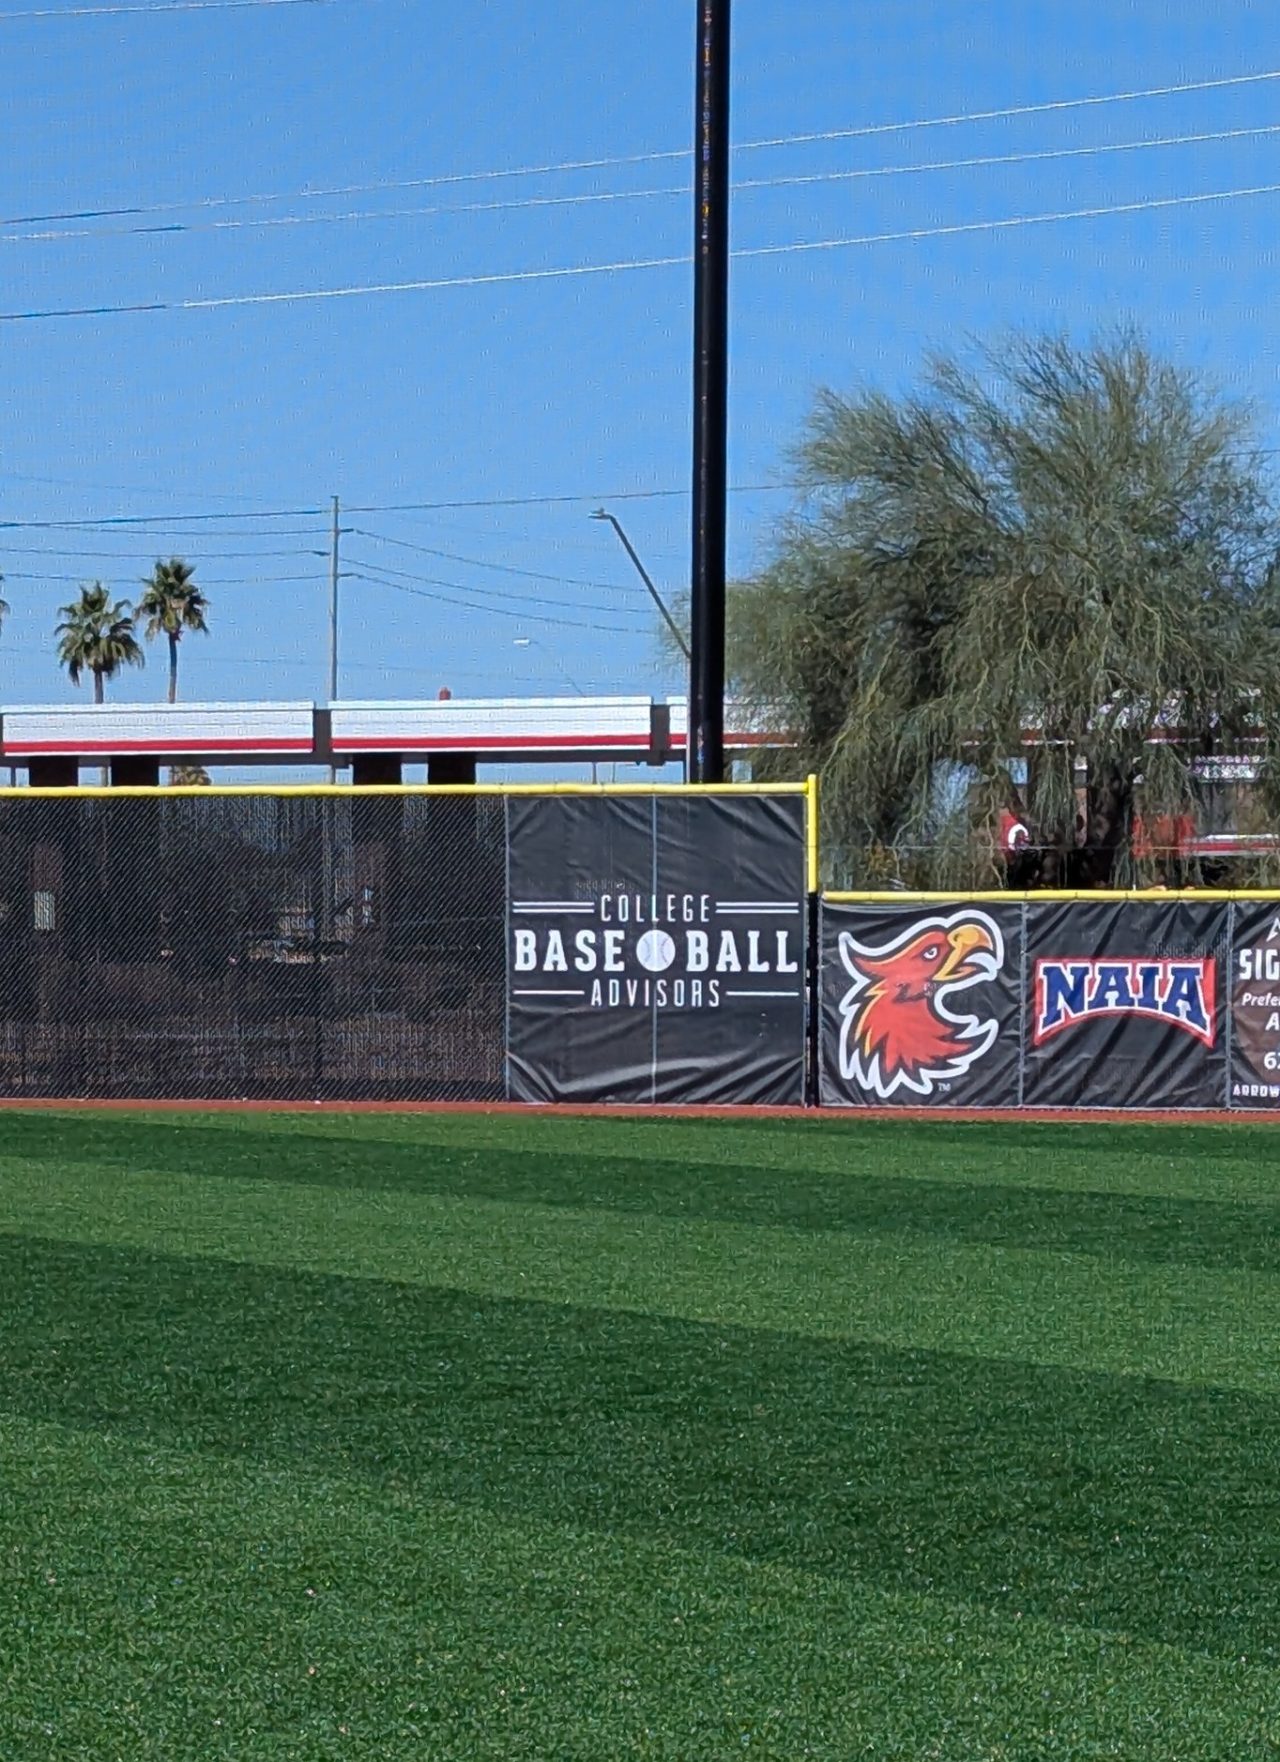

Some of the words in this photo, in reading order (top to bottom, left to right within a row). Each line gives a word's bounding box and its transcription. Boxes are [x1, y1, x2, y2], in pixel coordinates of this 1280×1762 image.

[601, 894, 710, 922] COLLEGE
[591, 979, 720, 1007] ADVISORS
[1036, 960, 1214, 1043] NAIA
[938, 1083, 951, 1092] TM
